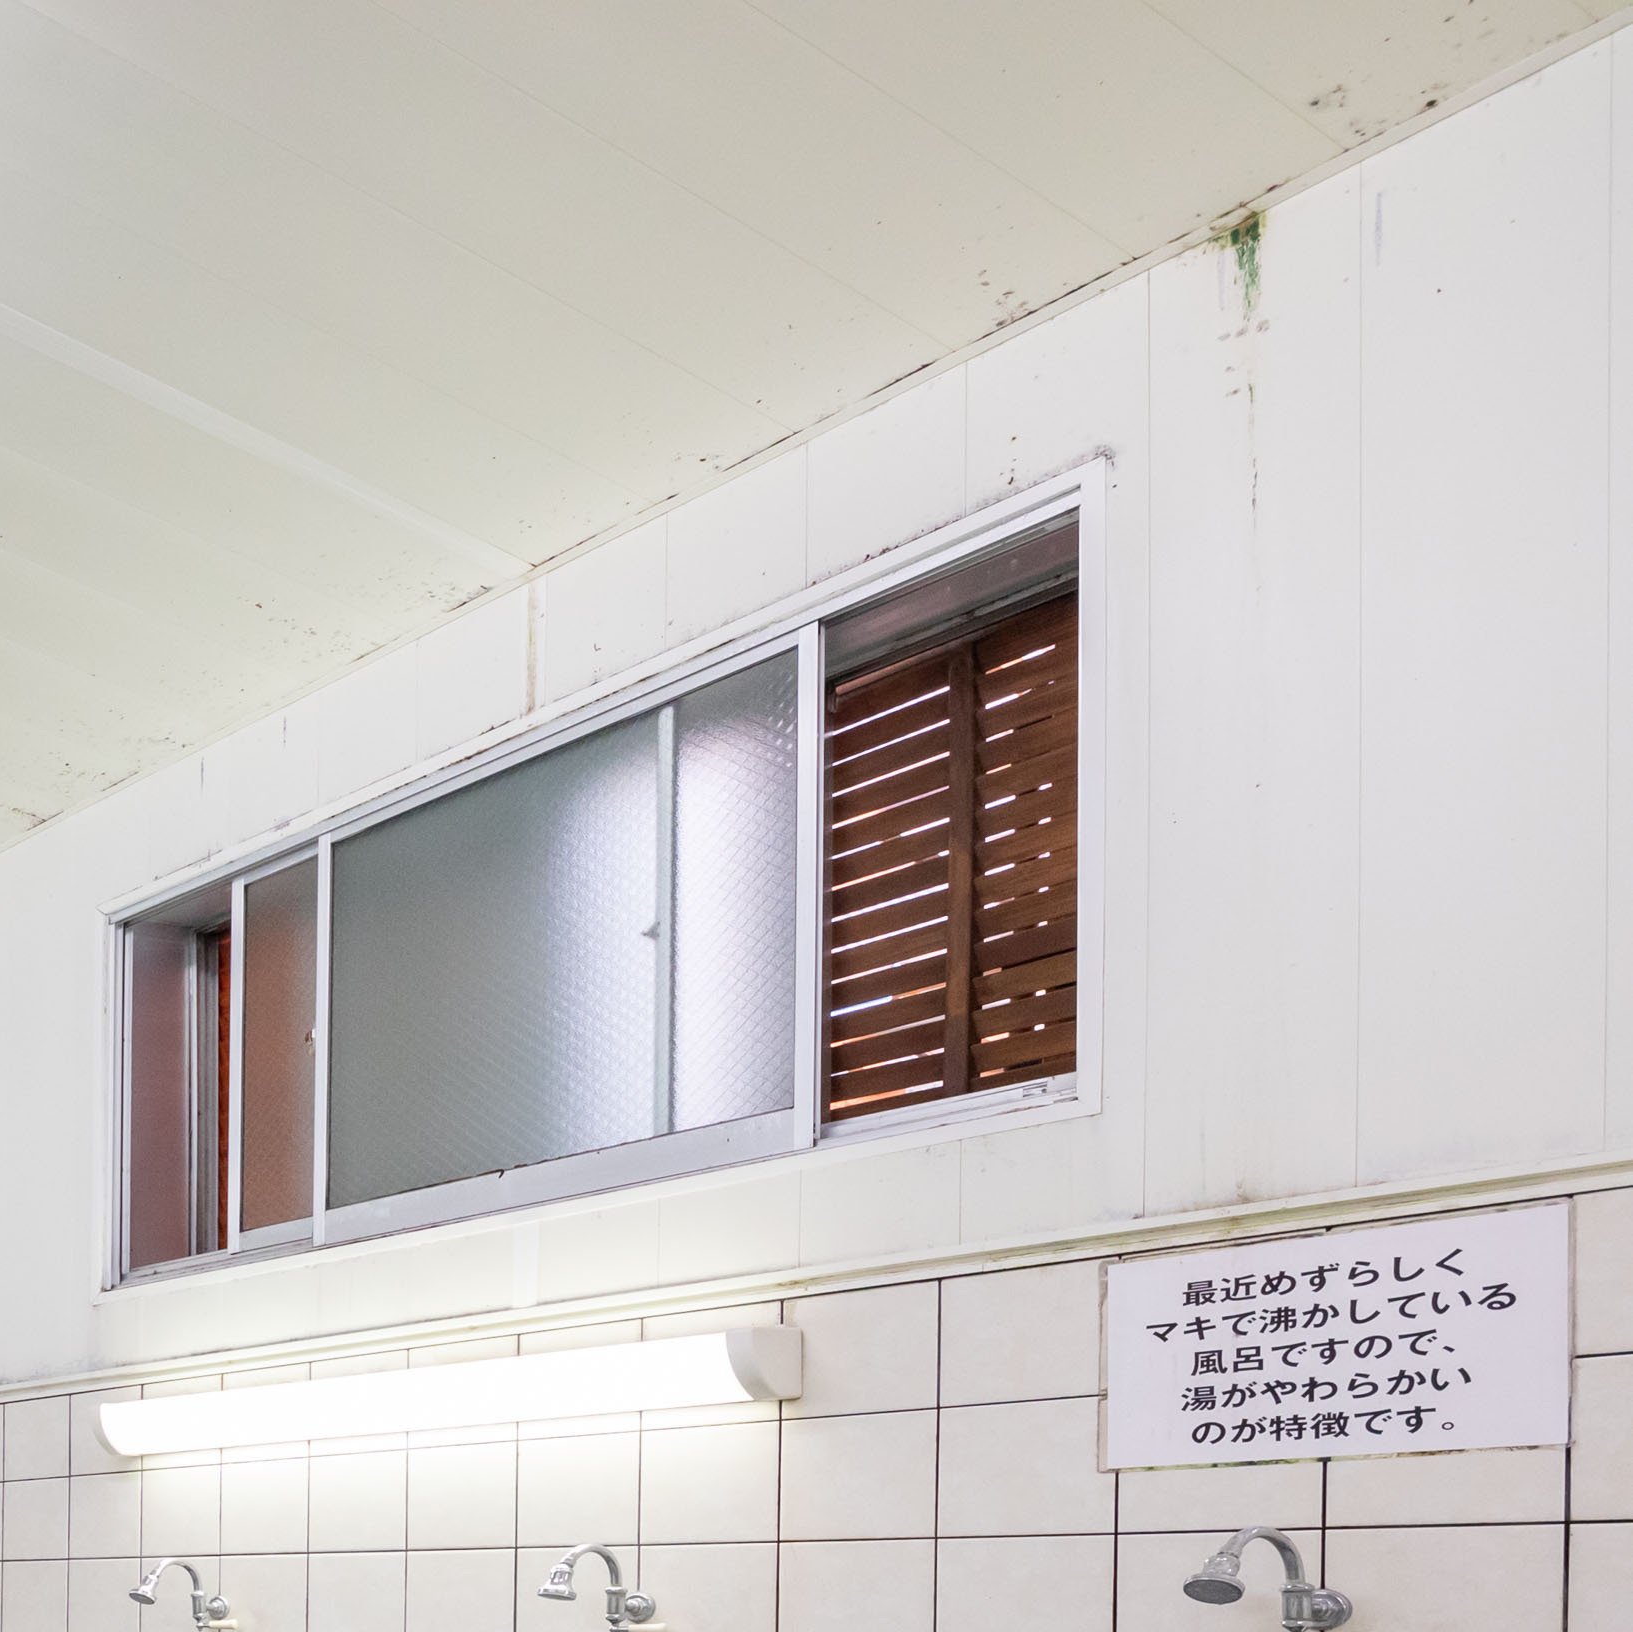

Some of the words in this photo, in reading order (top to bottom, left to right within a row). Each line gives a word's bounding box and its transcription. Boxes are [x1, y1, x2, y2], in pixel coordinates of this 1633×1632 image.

[1181, 1247, 1465, 1307] 最近めずらしく
[1145, 1281, 1518, 1343] マキで沸かしている
[1190, 1329, 1457, 1377] 風呂ですので、
[1181, 1366, 1472, 1413] 湯がやわらかい
[1191, 1406, 1455, 1445] のが特徴です。
